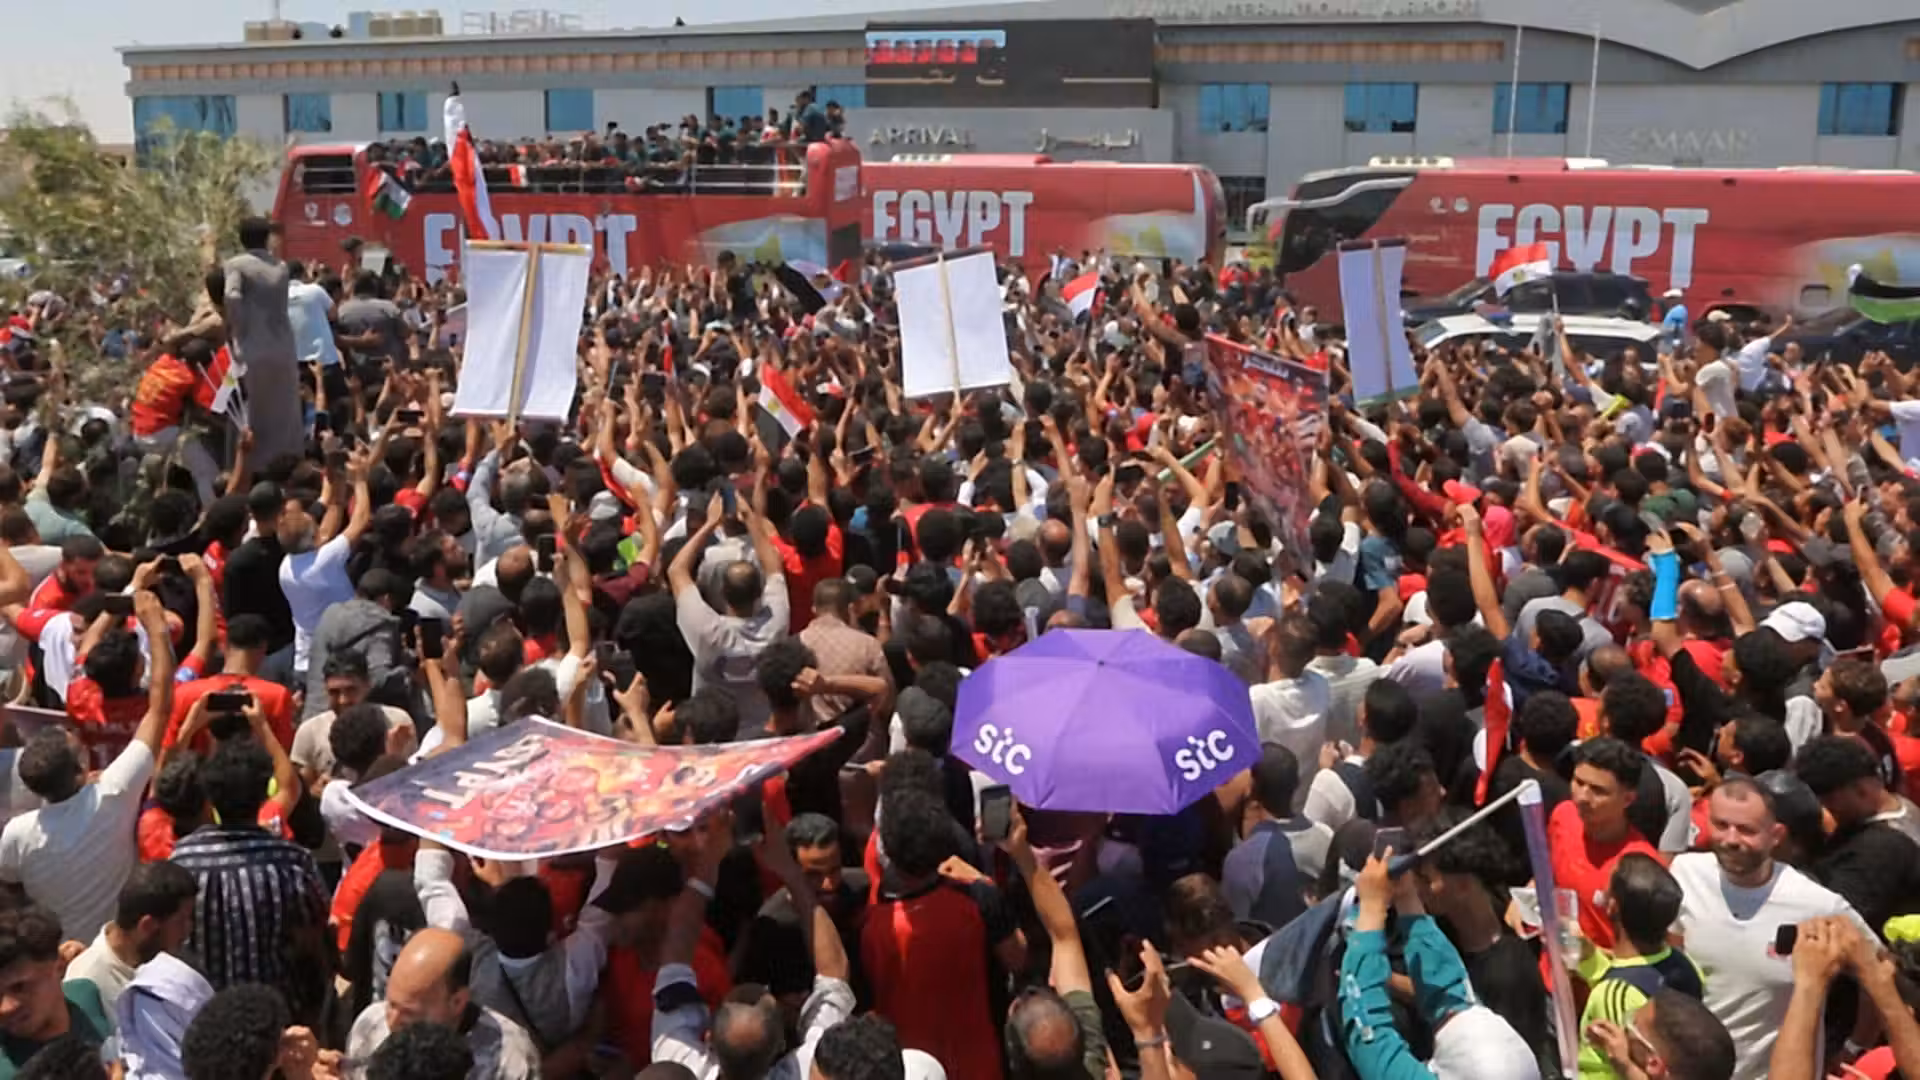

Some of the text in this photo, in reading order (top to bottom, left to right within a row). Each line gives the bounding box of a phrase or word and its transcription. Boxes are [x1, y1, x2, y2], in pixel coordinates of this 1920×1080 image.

[873, 189, 1033, 257] EGYPT
[1476, 203, 1709, 289] EGYPT
[973, 723, 1032, 776] stc
[1175, 729, 1235, 782] stc
